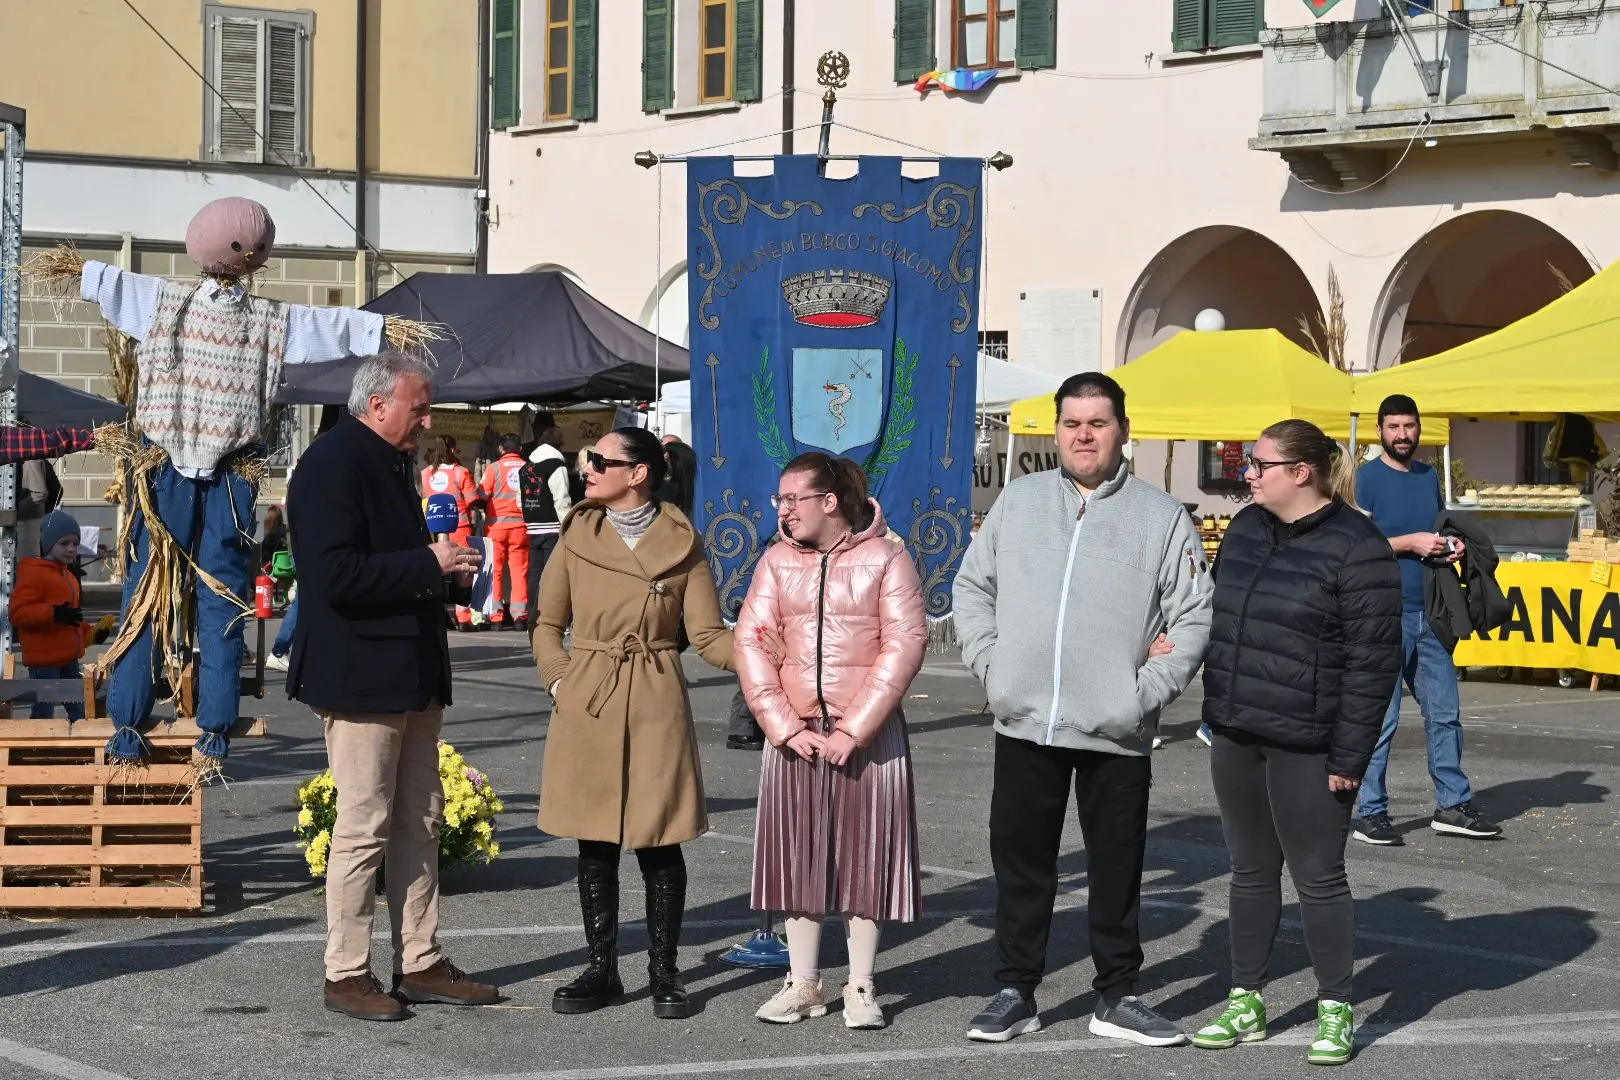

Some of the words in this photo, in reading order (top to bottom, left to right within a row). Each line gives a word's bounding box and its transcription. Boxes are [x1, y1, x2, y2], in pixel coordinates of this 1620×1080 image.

[713, 241, 781, 298] COMUNE
[780, 240, 795, 255] DI
[800, 232, 860, 252] BORGO
[881, 239, 952, 292] GIACOMO
[1459, 586, 1620, 650] ANA
